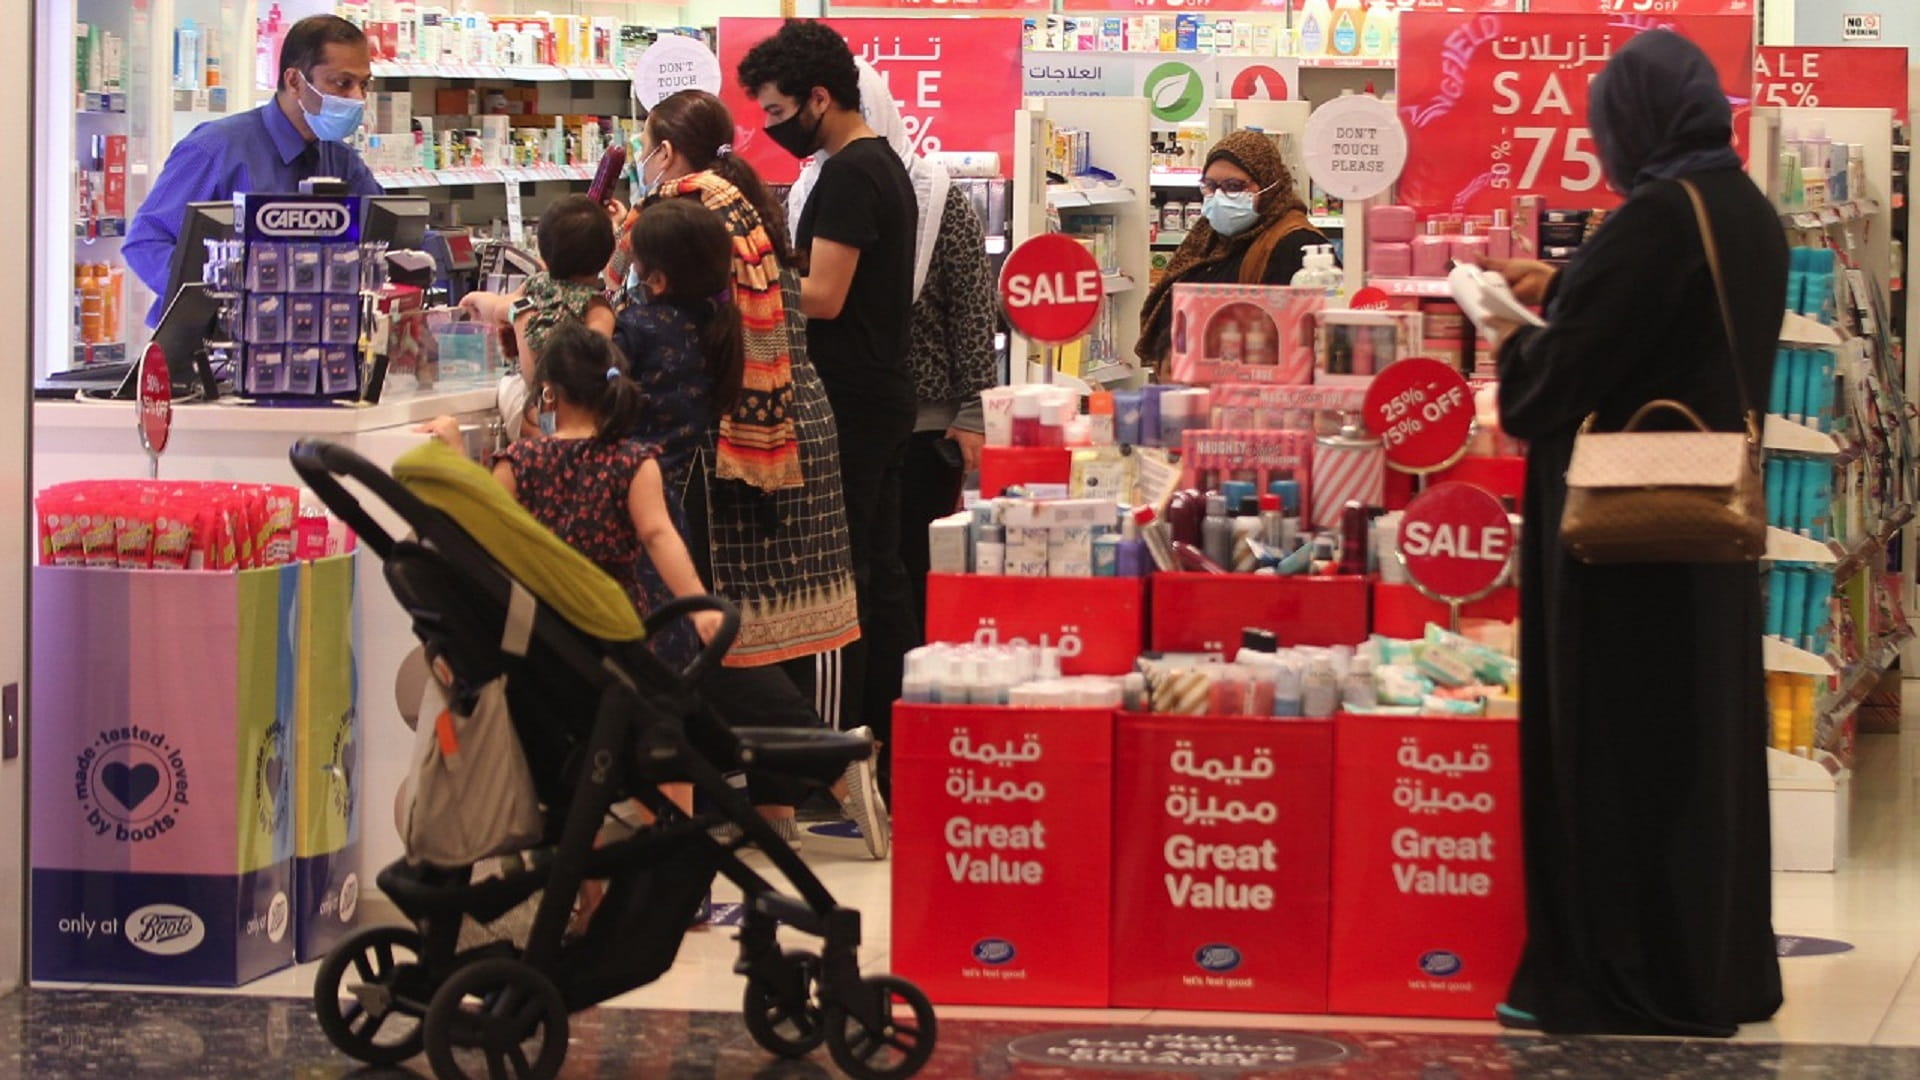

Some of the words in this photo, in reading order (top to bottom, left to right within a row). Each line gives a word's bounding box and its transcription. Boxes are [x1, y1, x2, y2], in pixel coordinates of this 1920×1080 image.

[1845, 28, 1879, 36] SMOKING
[1847, 17, 1862, 28] NO
[659, 61, 694, 74] DON'T
[1492, 34, 1612, 69] نزيلات
[1753, 53, 1820, 78] ALE
[657, 75, 697, 88] TOUCH
[881, 70, 942, 108] LE
[1029, 66, 1102, 83] العلاجات
[1492, 71, 1600, 115] SA
[1332, 143, 1379, 156] TOUCH
[1336, 127, 1377, 139] DON'T
[1331, 159, 1384, 172] PLEASE
[1514, 127, 1606, 192] 75
[265, 210, 337, 229] CAFLON
[1008, 270, 1098, 308] SALE
[1380, 387, 1424, 422] 25%
[1422, 386, 1463, 422] OFF
[1403, 521, 1507, 560] SALE
[75, 747, 96, 801] made
[100, 724, 165, 748] tested
[167, 748, 189, 805] loved
[950, 727, 1042, 768] قيمة
[1170, 740, 1275, 785] قيمة
[1397, 737, 1492, 778] قيمة
[946, 767, 1046, 805] مميزة
[1393, 778, 1495, 815] مميزة
[1165, 785, 1277, 826] مميزة
[86, 808, 112, 836] by
[115, 814, 176, 842] boots
[944, 816, 1046, 849] Great
[1164, 835, 1278, 871] Great
[1391, 827, 1495, 861] Great
[945, 852, 1044, 884] Value
[1392, 863, 1492, 896] Value
[1164, 873, 1275, 911] Value
[58, 911, 96, 940] only
[100, 917, 118, 934] at
[133, 912, 194, 944] Boots
